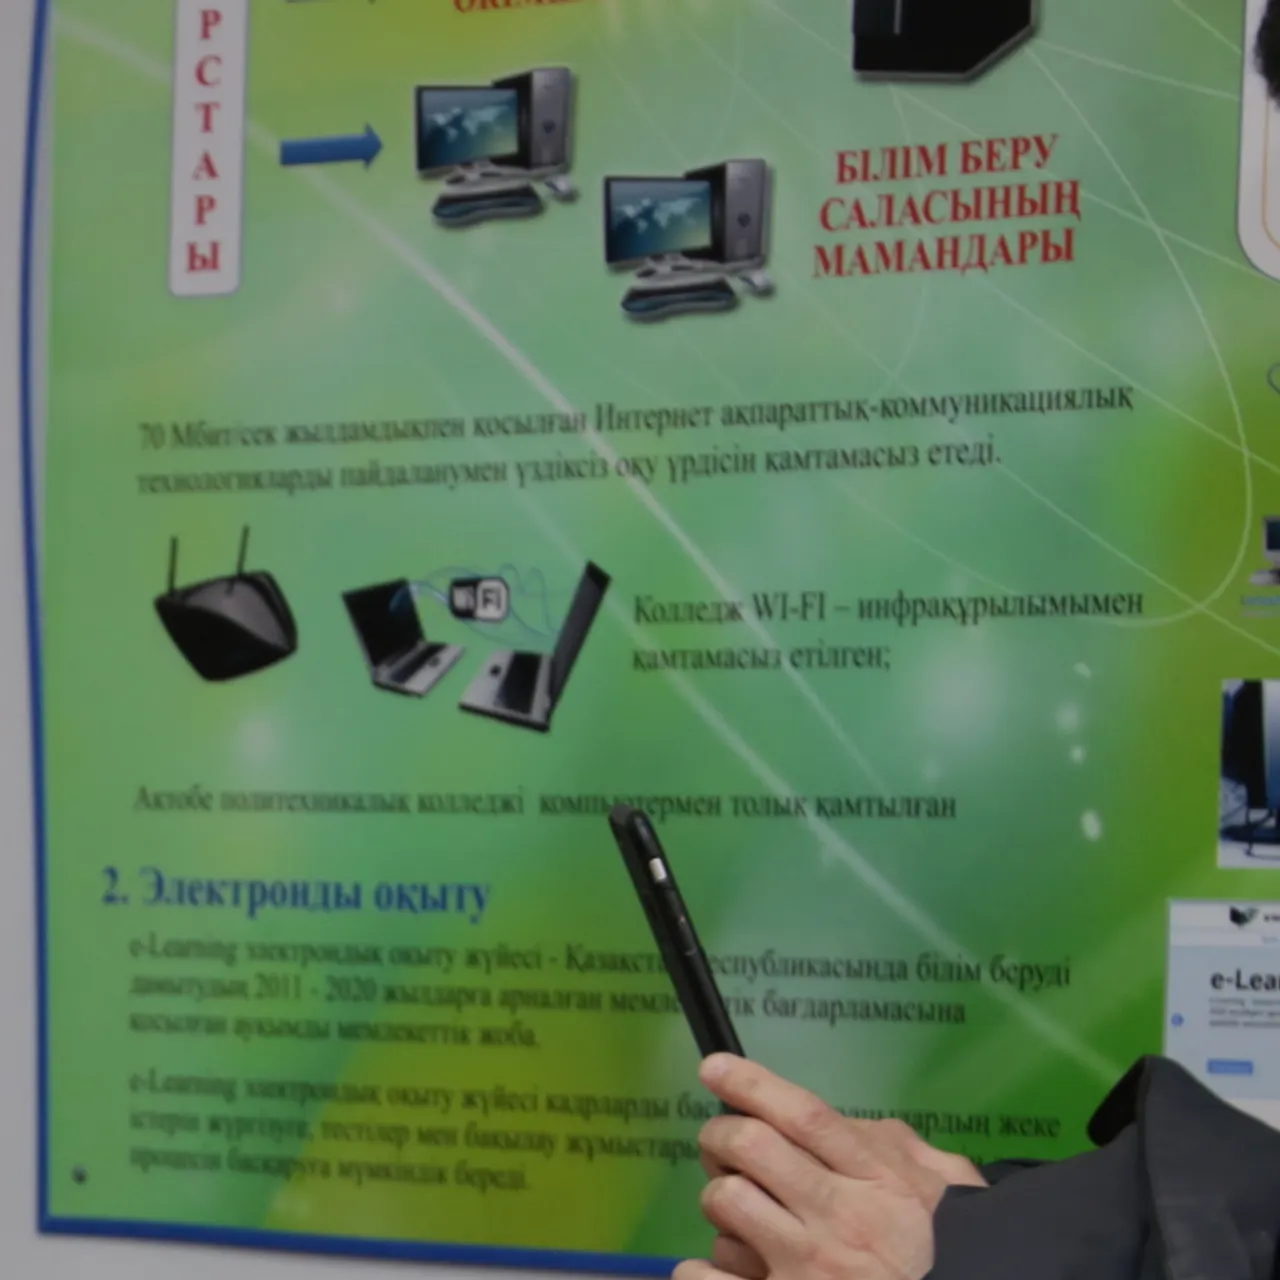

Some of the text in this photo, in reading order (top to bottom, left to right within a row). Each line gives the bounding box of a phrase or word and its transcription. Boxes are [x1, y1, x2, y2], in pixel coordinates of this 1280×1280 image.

[834, 132, 1060, 185] БІЛІМ БЕРУ
[818, 178, 1082, 233] САЛАСЫНЫҢ
[811, 226, 1076, 279] МАМАНДАРЫ
[594, 402, 712, 437] Интернет
[765, 446, 919, 477] қамтамасыз
[927, 432, 1002, 468] етеді.
[635, 596, 741, 625] Колледж
[754, 593, 826, 622] WI-FI
[858, 592, 1144, 627] инфрақұрылымымен
[633, 639, 891, 671] қамтамасыз етілген;
[99, 864, 493, 925] 2. Электронды оқыту
[253, 972, 302, 1000] 2011
[325, 976, 377, 1002] 2020
[917, 952, 981, 983] білім
[989, 955, 1072, 991] беруді
[1210, 967, 1280, 992] e-Lea
[999, 1113, 1061, 1138] жеке
